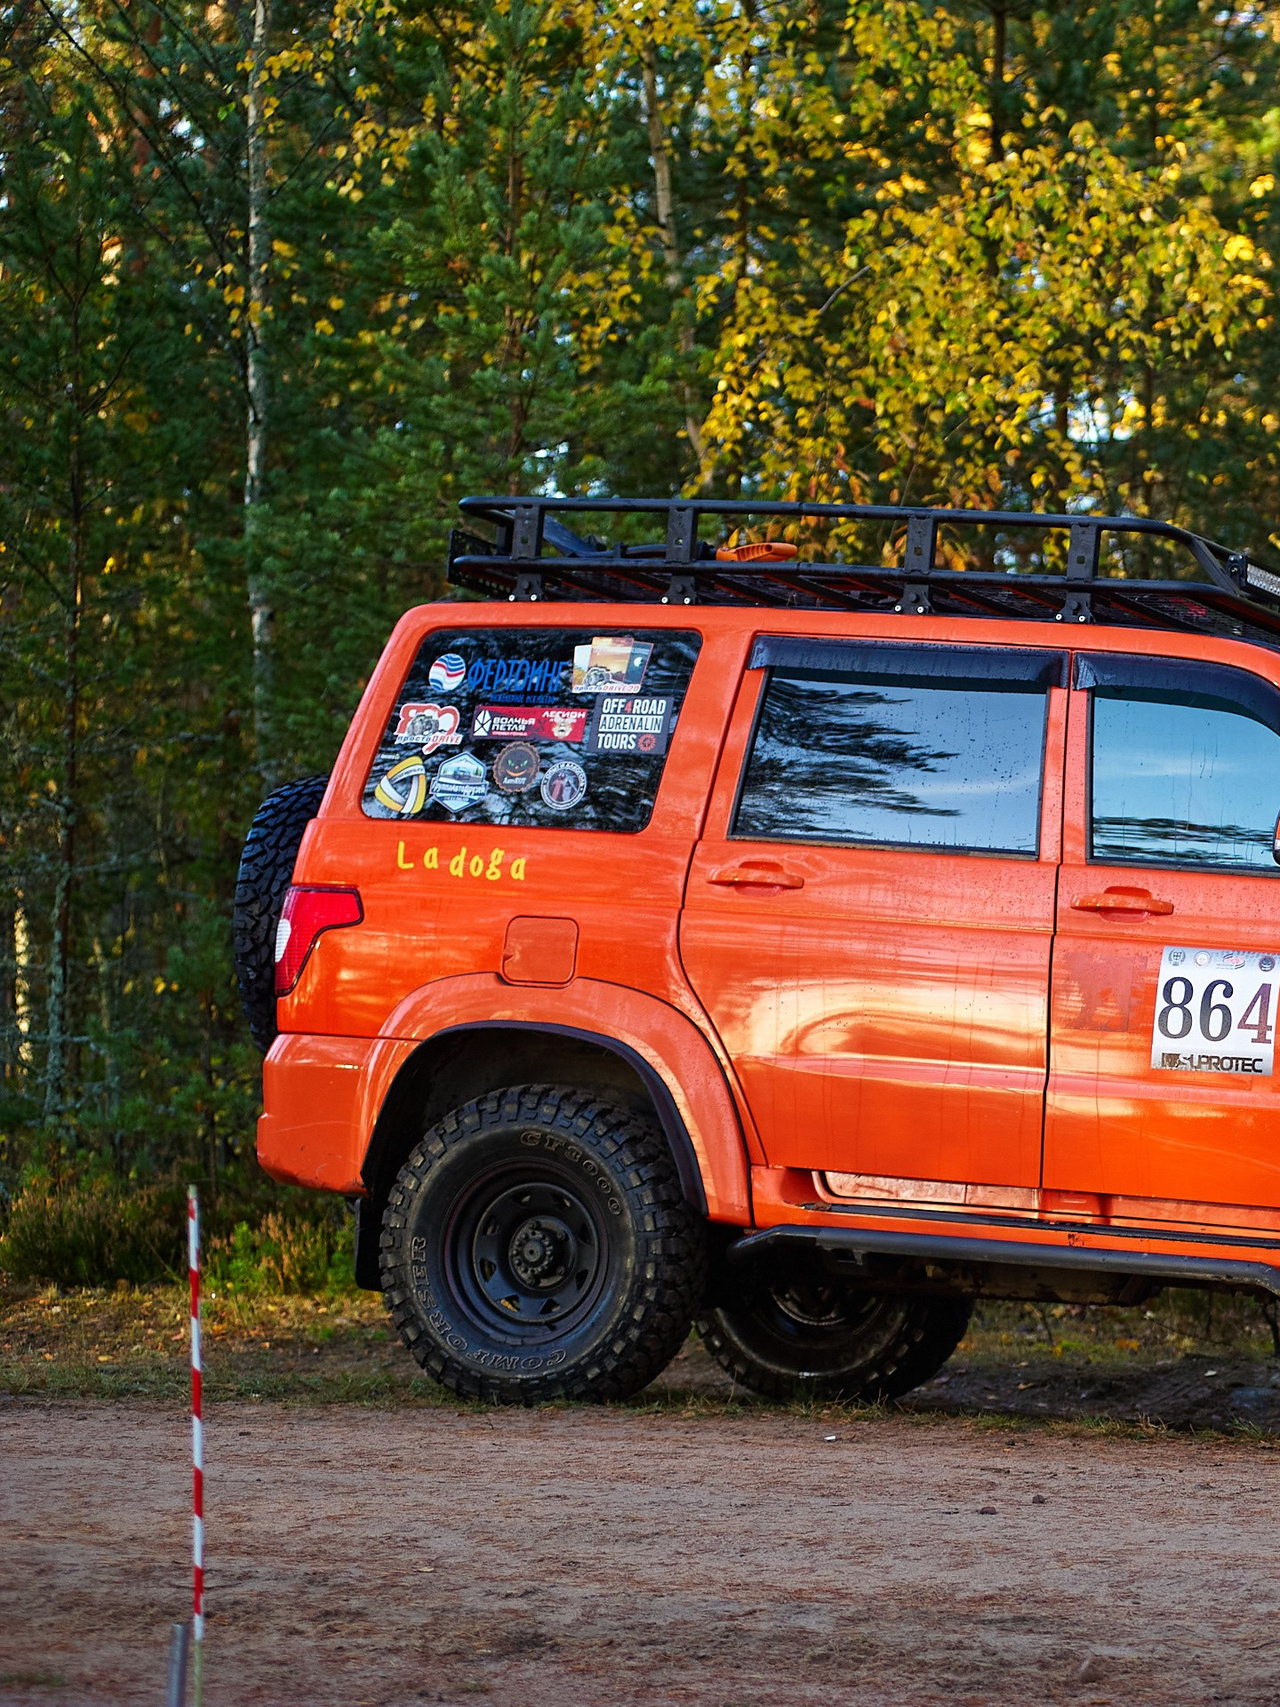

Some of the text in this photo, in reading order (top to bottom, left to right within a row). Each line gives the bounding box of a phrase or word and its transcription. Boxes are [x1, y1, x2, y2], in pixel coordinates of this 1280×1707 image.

[467, 657, 569, 693] ФЕРТОИНГ
[542, 710, 586, 718] ЛЕГИОН
[602, 698, 667, 715] OFF4ROAD
[491, 723, 527, 731] ПЕТЛЯ
[492, 717, 536, 725] ВОЛЧЬЯ
[600, 715, 662, 731] ADRENALIN
[597, 733, 637, 749] TOURS
[1158, 976, 1273, 1045] 864
[1178, 1053, 1264, 1074] SUPROTEC
[410, 1236, 568, 1371] COMFORSER
